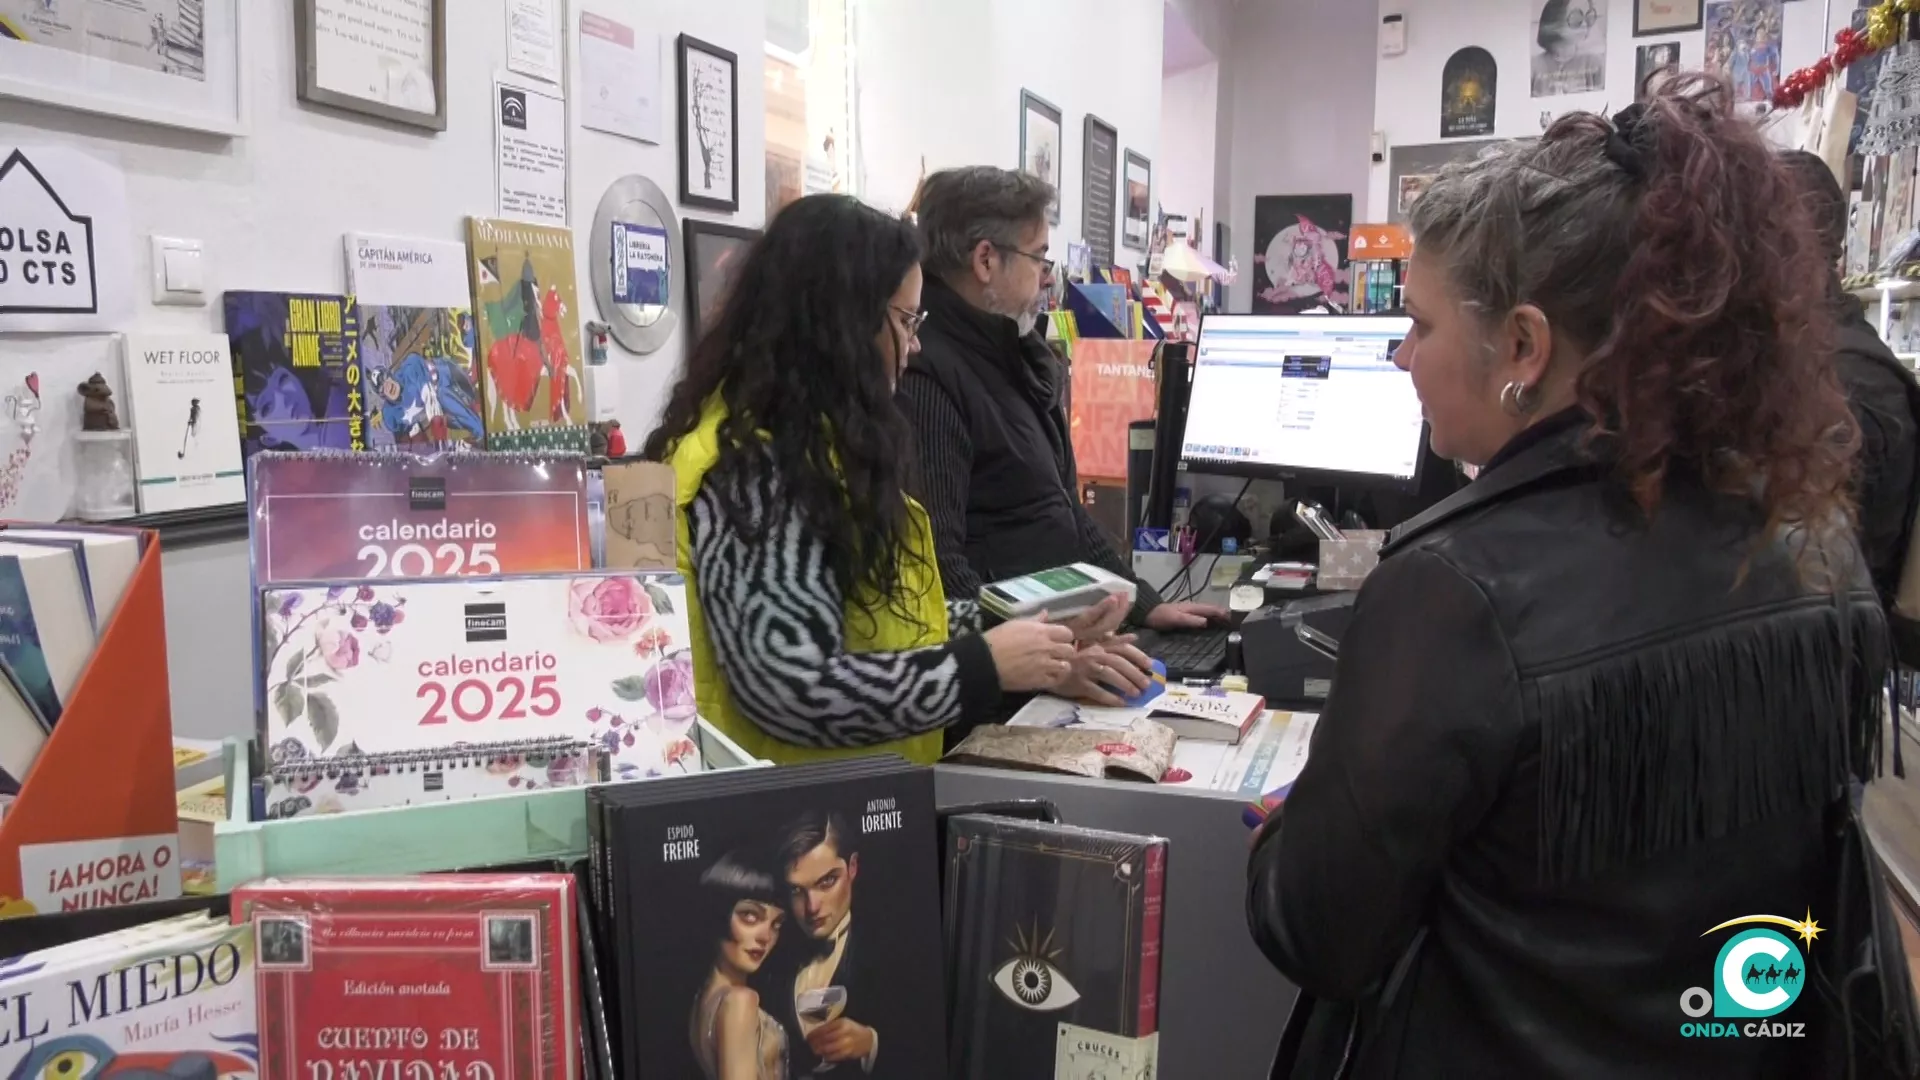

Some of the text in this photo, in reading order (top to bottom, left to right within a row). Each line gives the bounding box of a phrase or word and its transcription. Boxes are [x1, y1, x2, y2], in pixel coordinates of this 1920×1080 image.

[358, 245, 433, 265] CAPITÁN AMÉRICA
[22, 259, 77, 287] CTS
[289, 299, 316, 332] GRAN
[317, 300, 342, 332] LIBRO
[144, 351, 221, 365] WET FLOOR
[292, 333, 321, 367] ANIME
[411, 489, 445, 499] finocam
[358, 518, 497, 541] calendario
[356, 543, 501, 578] 2025
[467, 617, 505, 628] finocam
[418, 650, 557, 677] calendario
[416, 675, 562, 725] 2025
[866, 797, 896, 813] ANTONIO
[667, 824, 694, 840] ESPIDO
[862, 811, 903, 833] LORENTE
[663, 839, 700, 862] FREIRE
[49, 845, 171, 893] ¡AHORA O
[61, 875, 159, 912] NUNCA!
[67, 943, 241, 1028] MIEDO
[343, 979, 451, 996] Edición anotada
[124, 1000, 243, 1045] María Hesse
[317, 1026, 480, 1050] CUENTO DE
[1077, 1040, 1120, 1059] CRUCES
[305, 1058, 496, 1080] NAVIDAD
